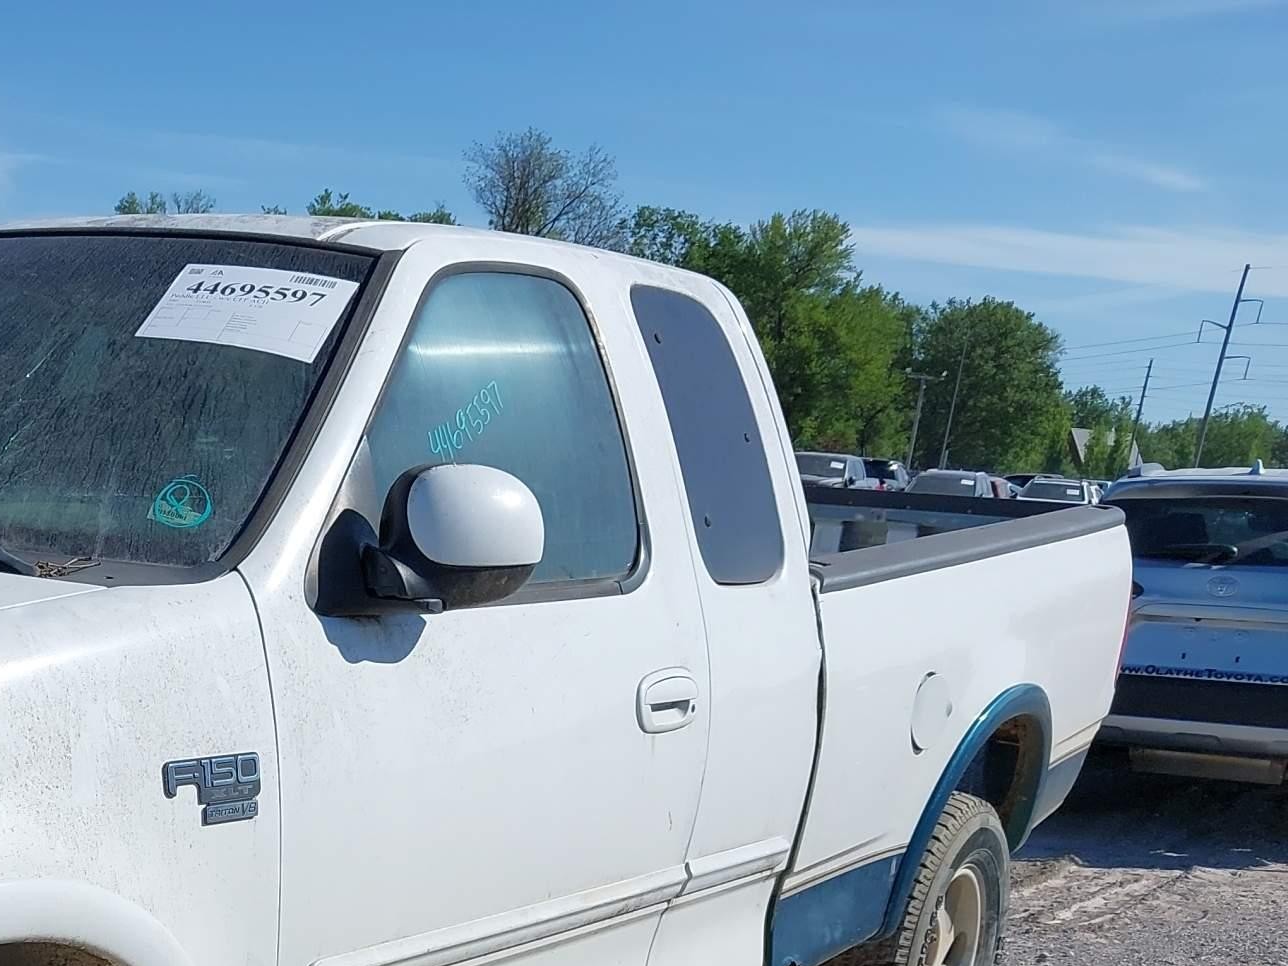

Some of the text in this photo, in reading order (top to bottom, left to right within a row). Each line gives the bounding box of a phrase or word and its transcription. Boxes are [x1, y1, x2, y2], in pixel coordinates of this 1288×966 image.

[186, 280, 327, 307] 44695597
[427, 380, 503, 464] 44695597
[167, 754, 260, 796] F-150
[212, 785, 254, 799] XLT
[209, 802, 257, 819] TRITON V8
